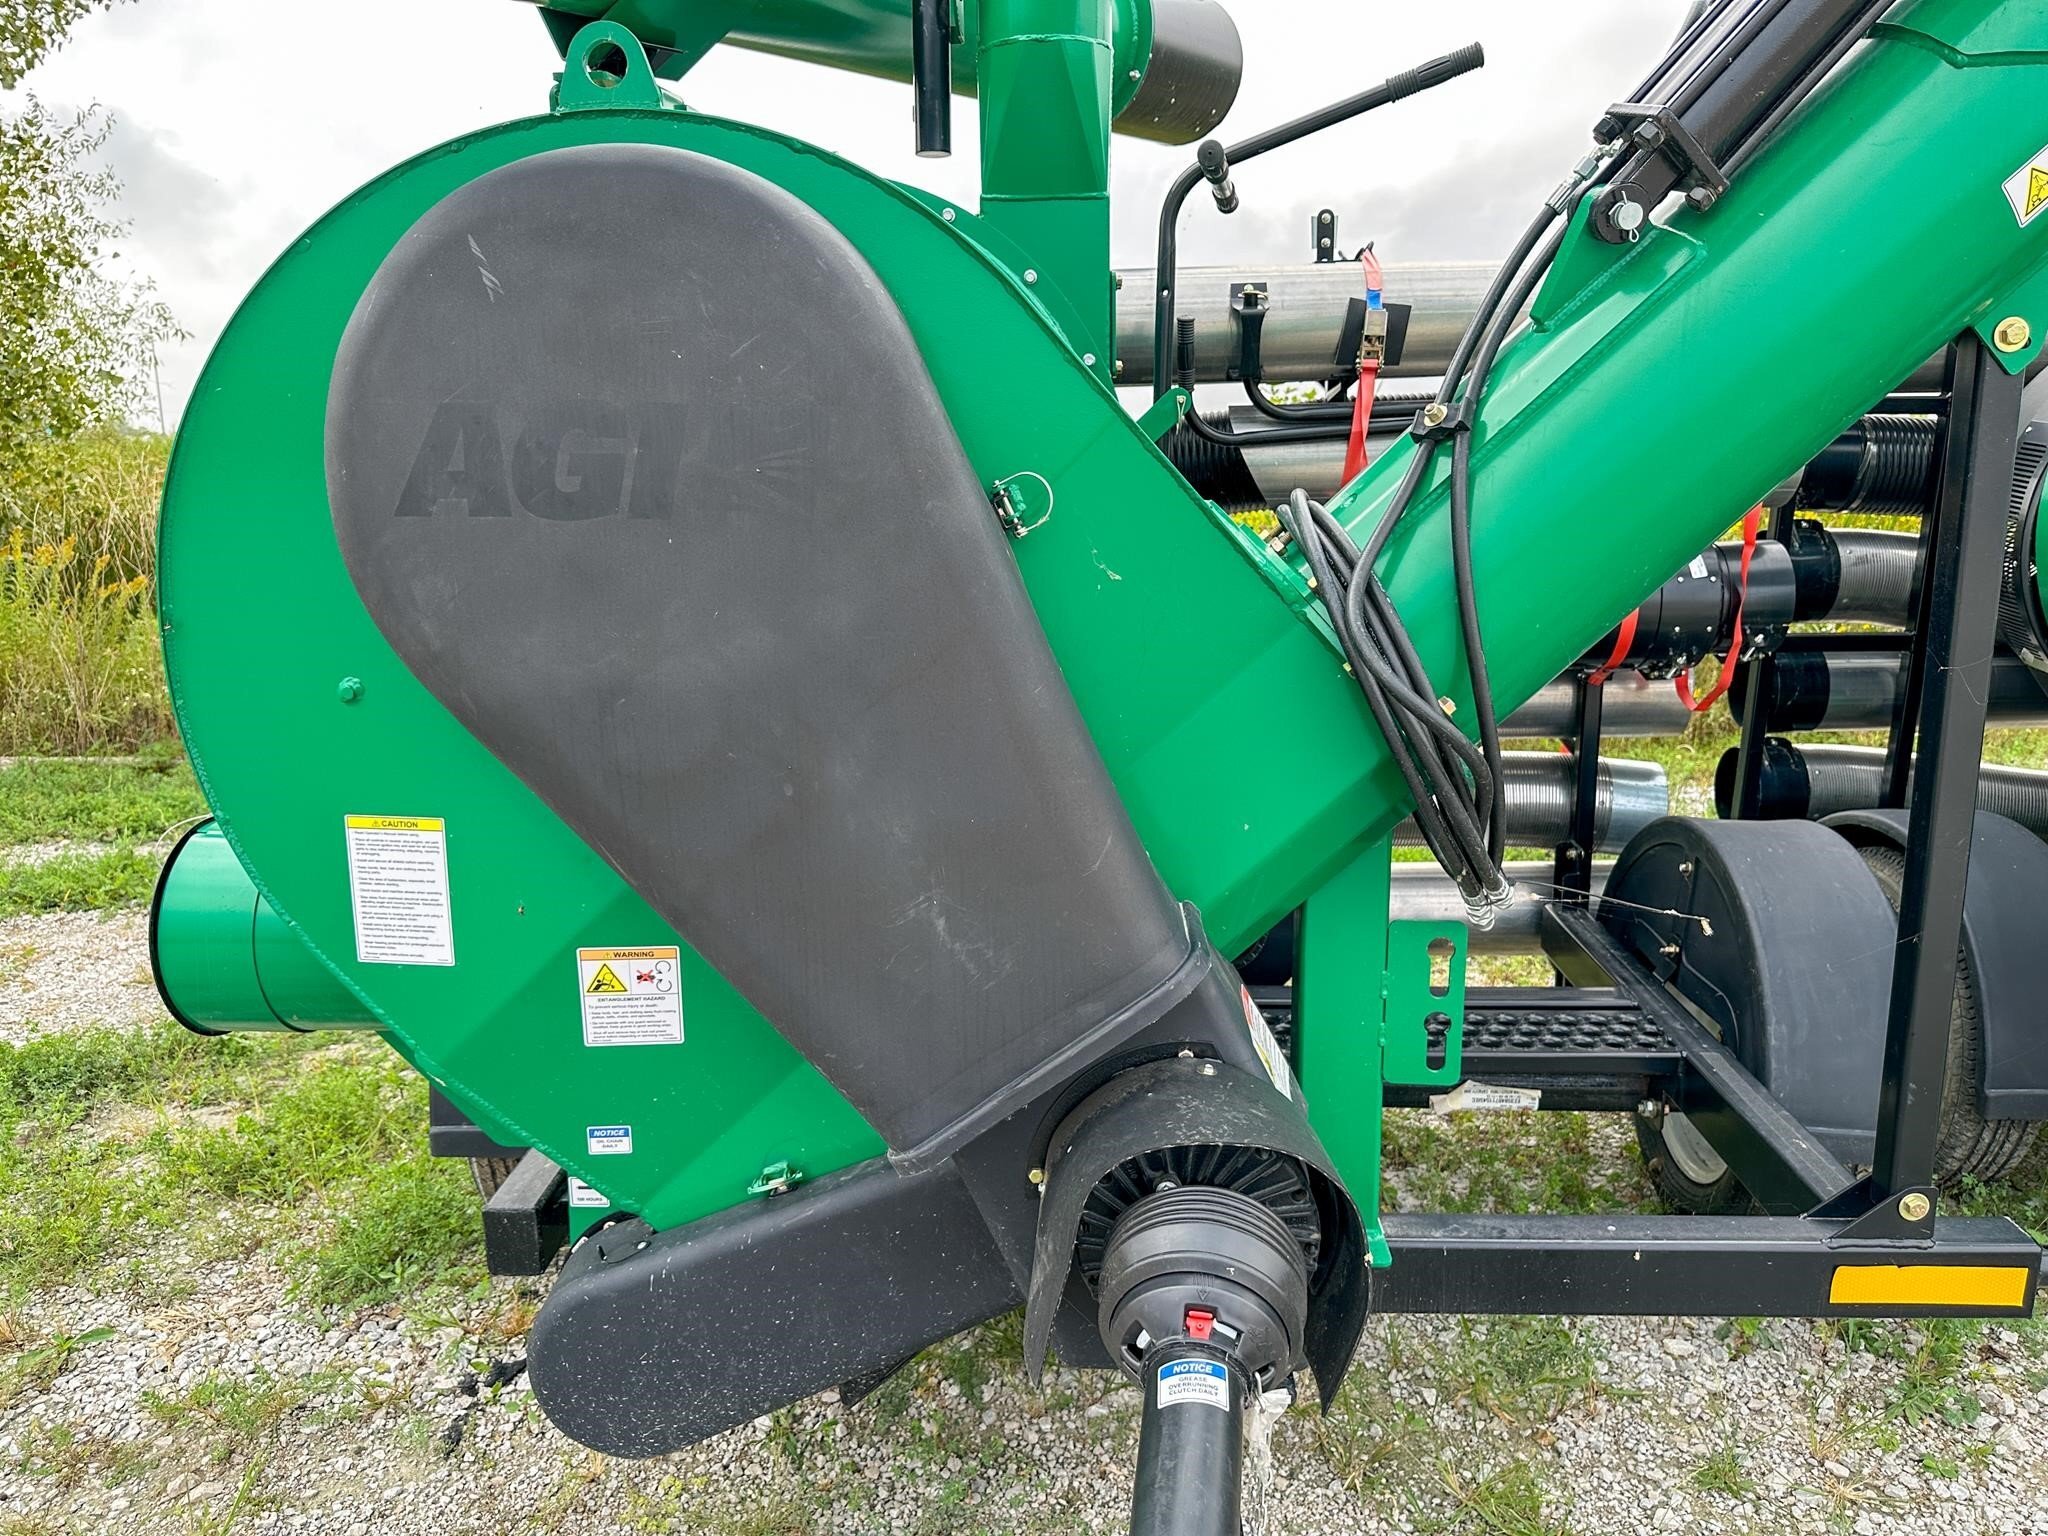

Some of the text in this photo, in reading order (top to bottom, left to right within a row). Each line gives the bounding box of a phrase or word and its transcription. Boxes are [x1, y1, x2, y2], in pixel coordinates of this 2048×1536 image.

[393, 399, 689, 521] AGI
[382, 820, 419, 828] CAUTION
[593, 1129, 625, 1137] NOTICE
[1173, 1363, 1213, 1374] NOTICE
[1168, 1382, 1219, 1391] OVERRUNNING
[1168, 1388, 1219, 1397] CLUTCH DAILY
